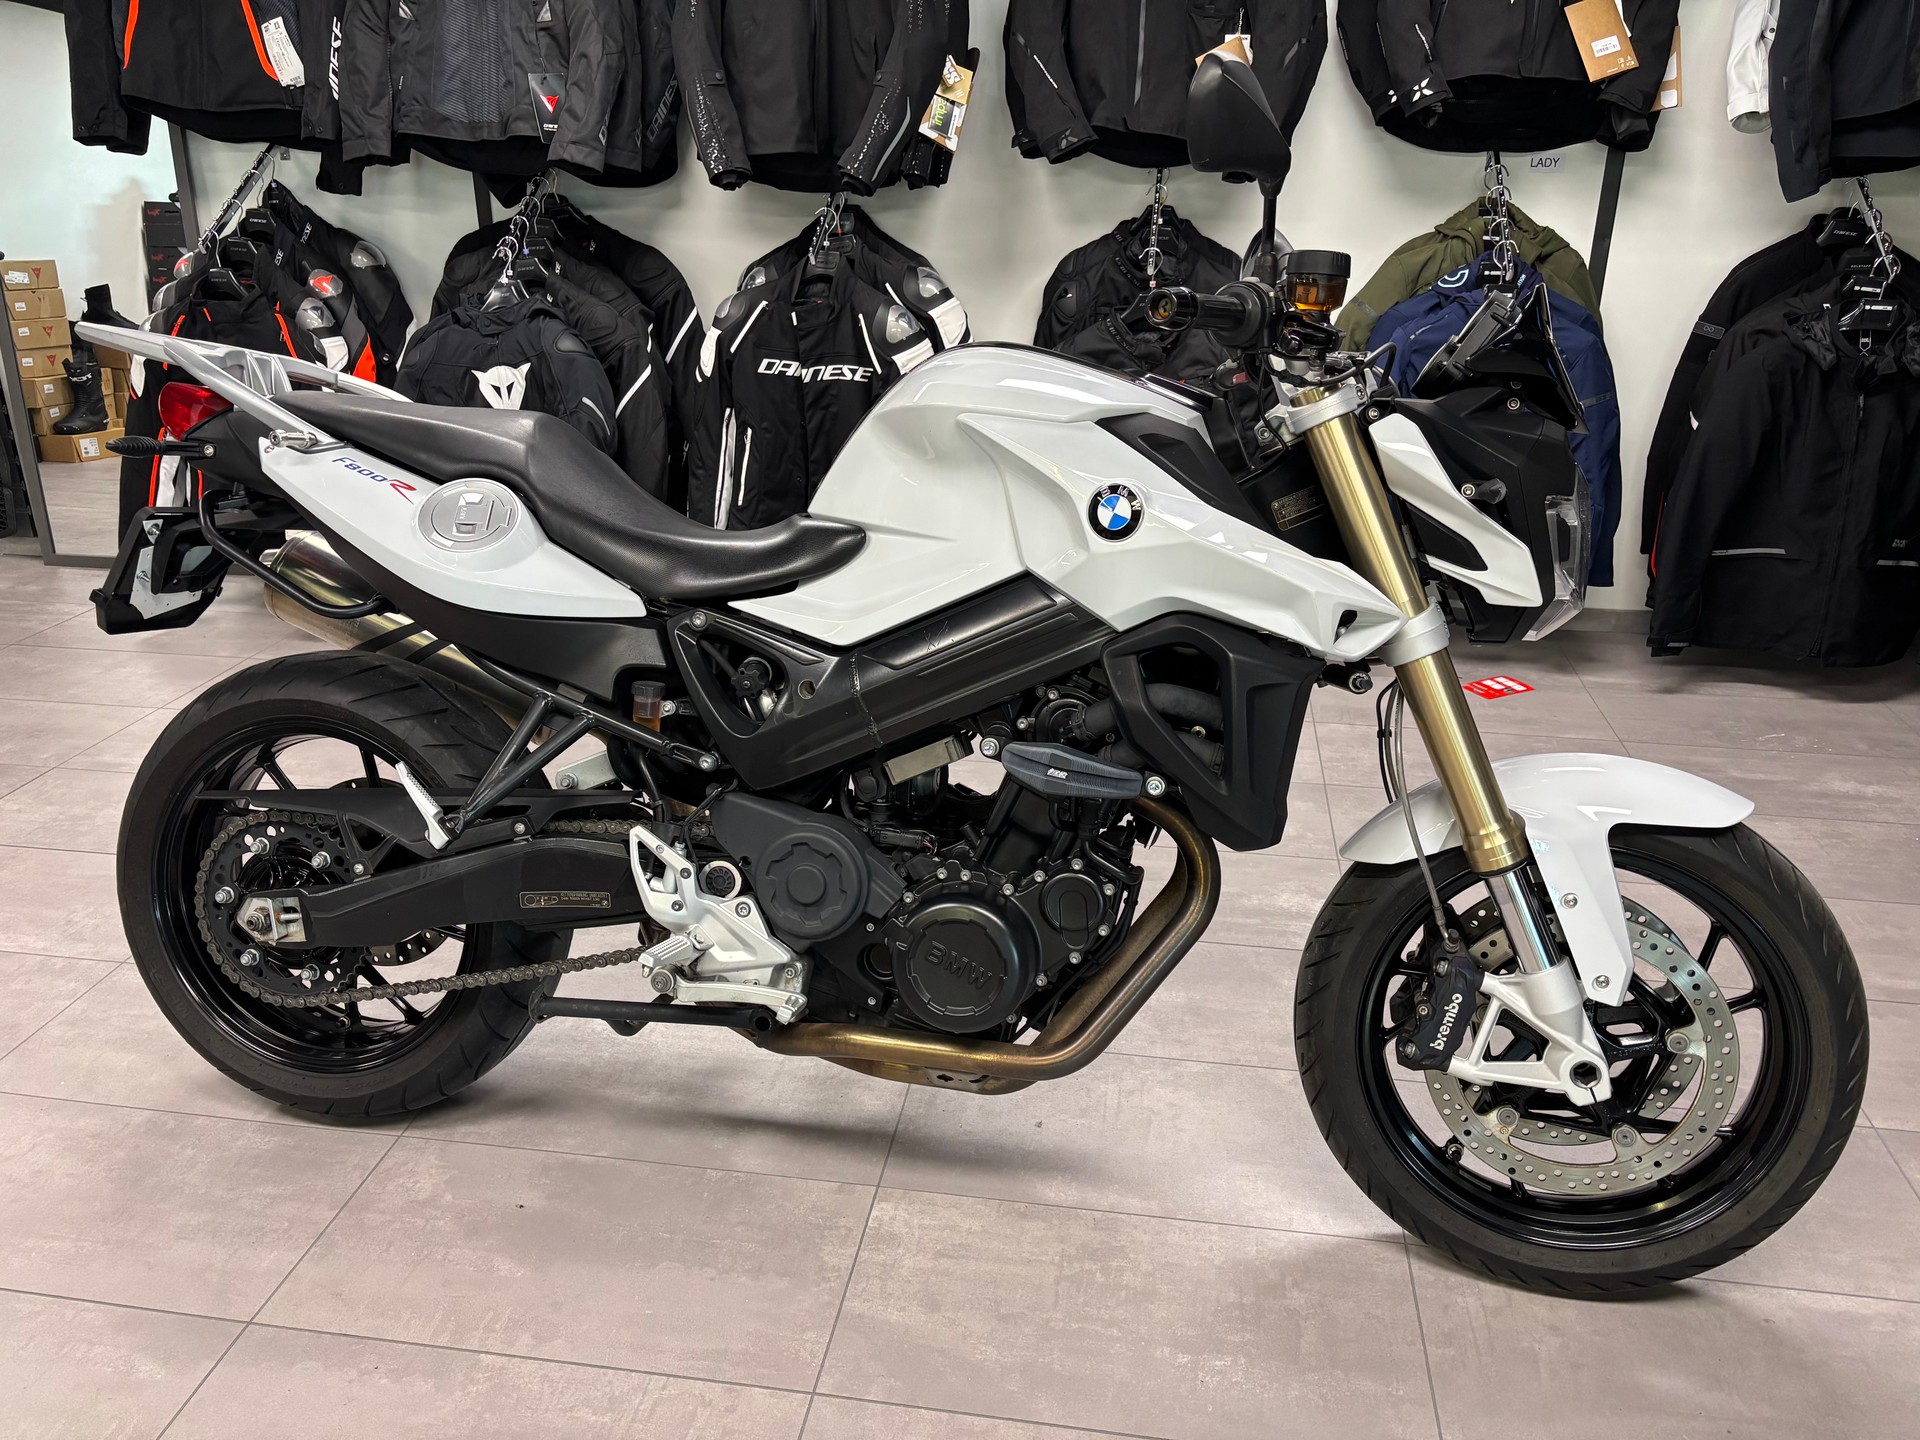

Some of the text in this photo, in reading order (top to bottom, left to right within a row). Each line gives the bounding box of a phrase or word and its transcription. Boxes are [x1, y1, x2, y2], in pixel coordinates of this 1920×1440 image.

[1530, 157, 1561, 168] LADY
[757, 358, 874, 384] DAINESE
[1100, 484, 1143, 512] BMW
[926, 940, 993, 990] BMW
[1429, 993, 1463, 1051] brembo
